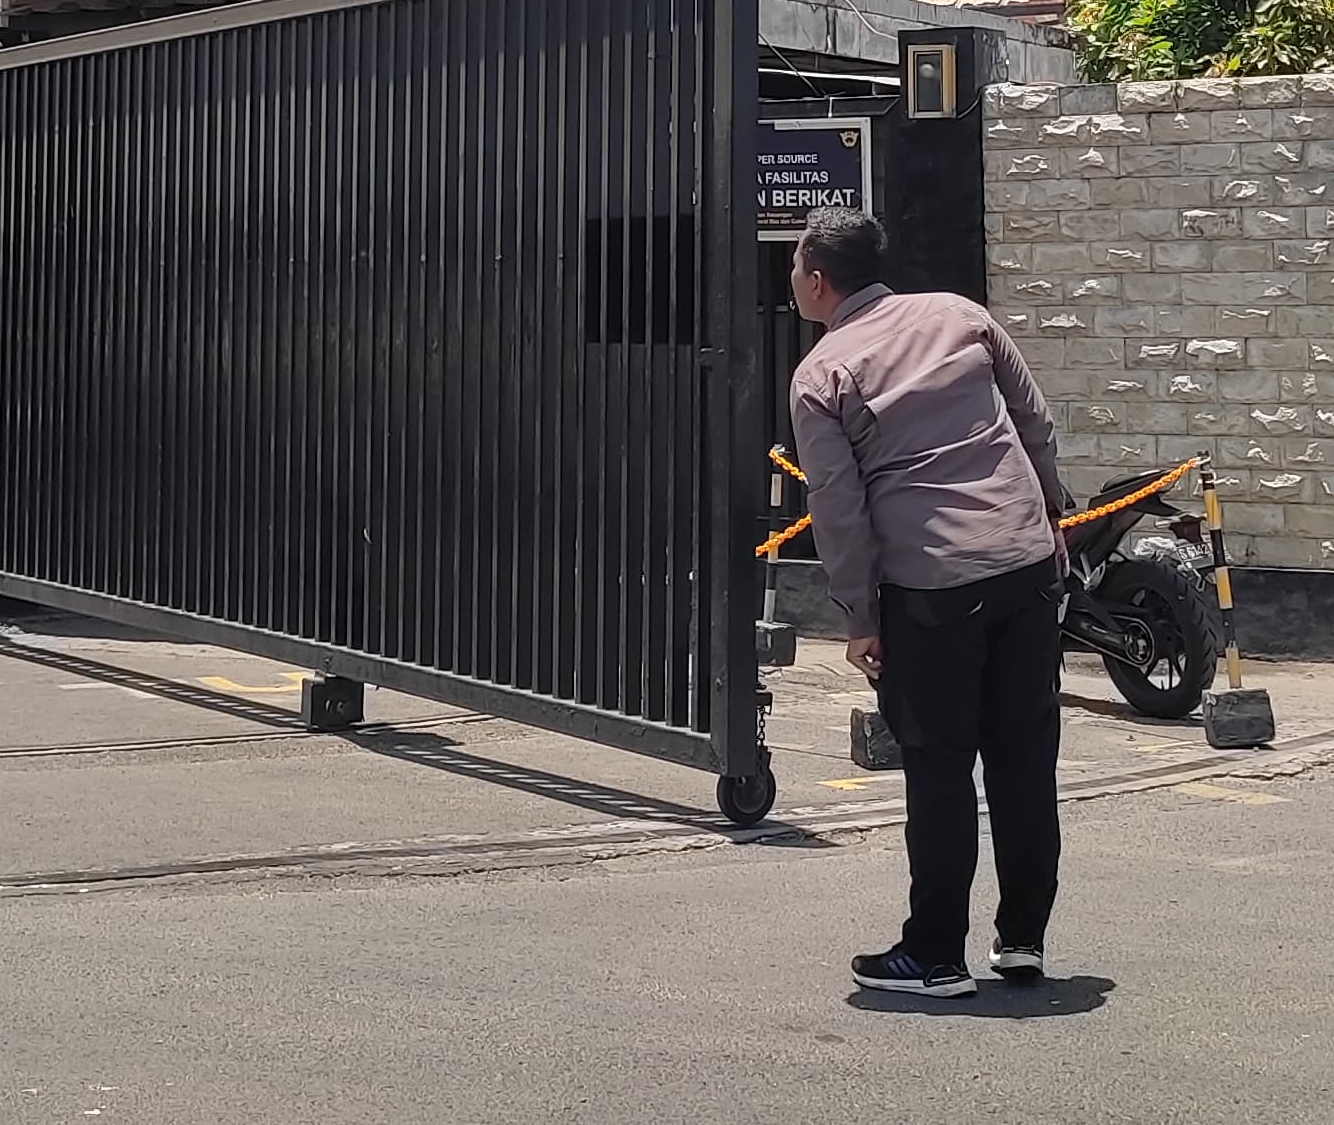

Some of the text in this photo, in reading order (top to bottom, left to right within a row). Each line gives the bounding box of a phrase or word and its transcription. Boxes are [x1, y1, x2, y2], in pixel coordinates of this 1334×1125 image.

[777, 154, 818, 164] SOURCE
[765, 171, 829, 185] FASILITAS
[772, 188, 855, 207] BERIKAT
